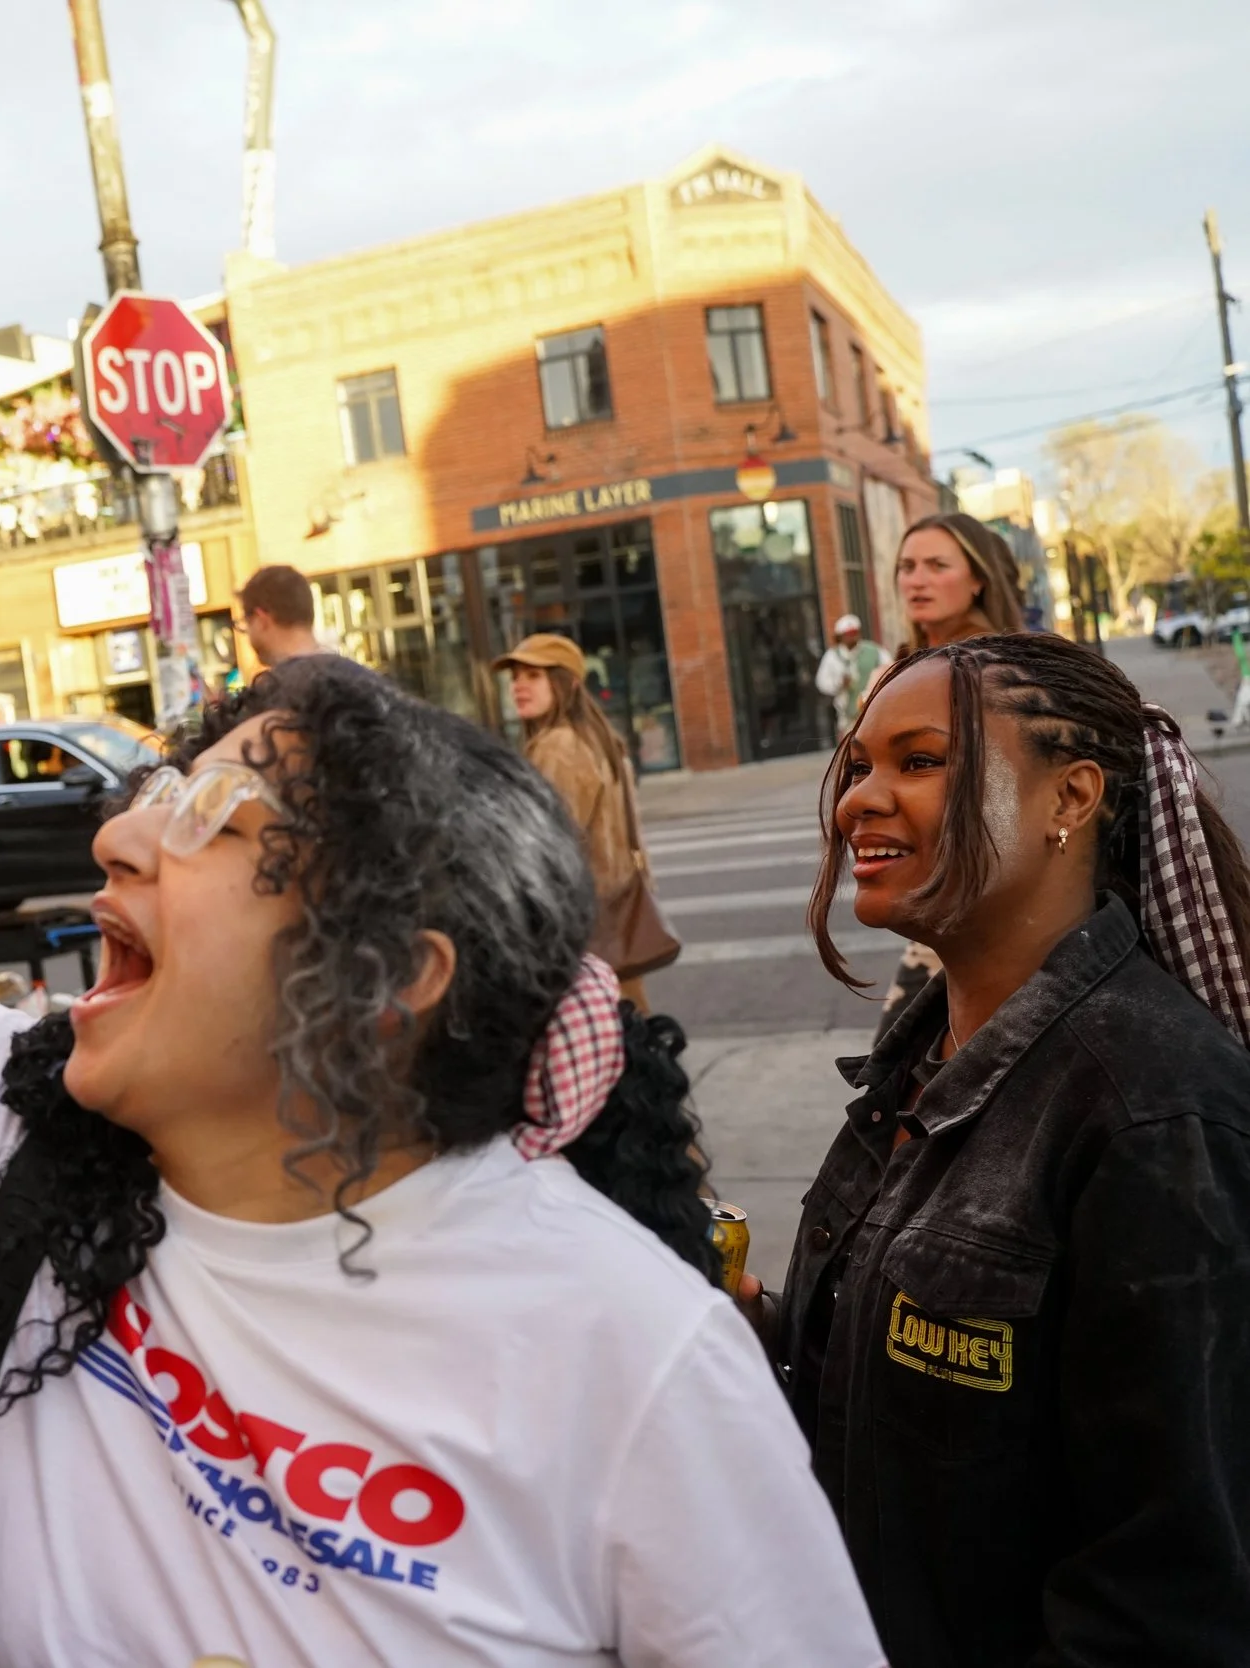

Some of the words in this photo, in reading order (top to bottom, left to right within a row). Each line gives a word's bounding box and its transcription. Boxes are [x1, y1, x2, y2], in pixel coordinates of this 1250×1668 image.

[97, 345, 218, 416] STOP
[499, 490, 579, 527] MARINE
[582, 478, 652, 513] LAYER
[169, 1430, 439, 1591] HOLESALE
